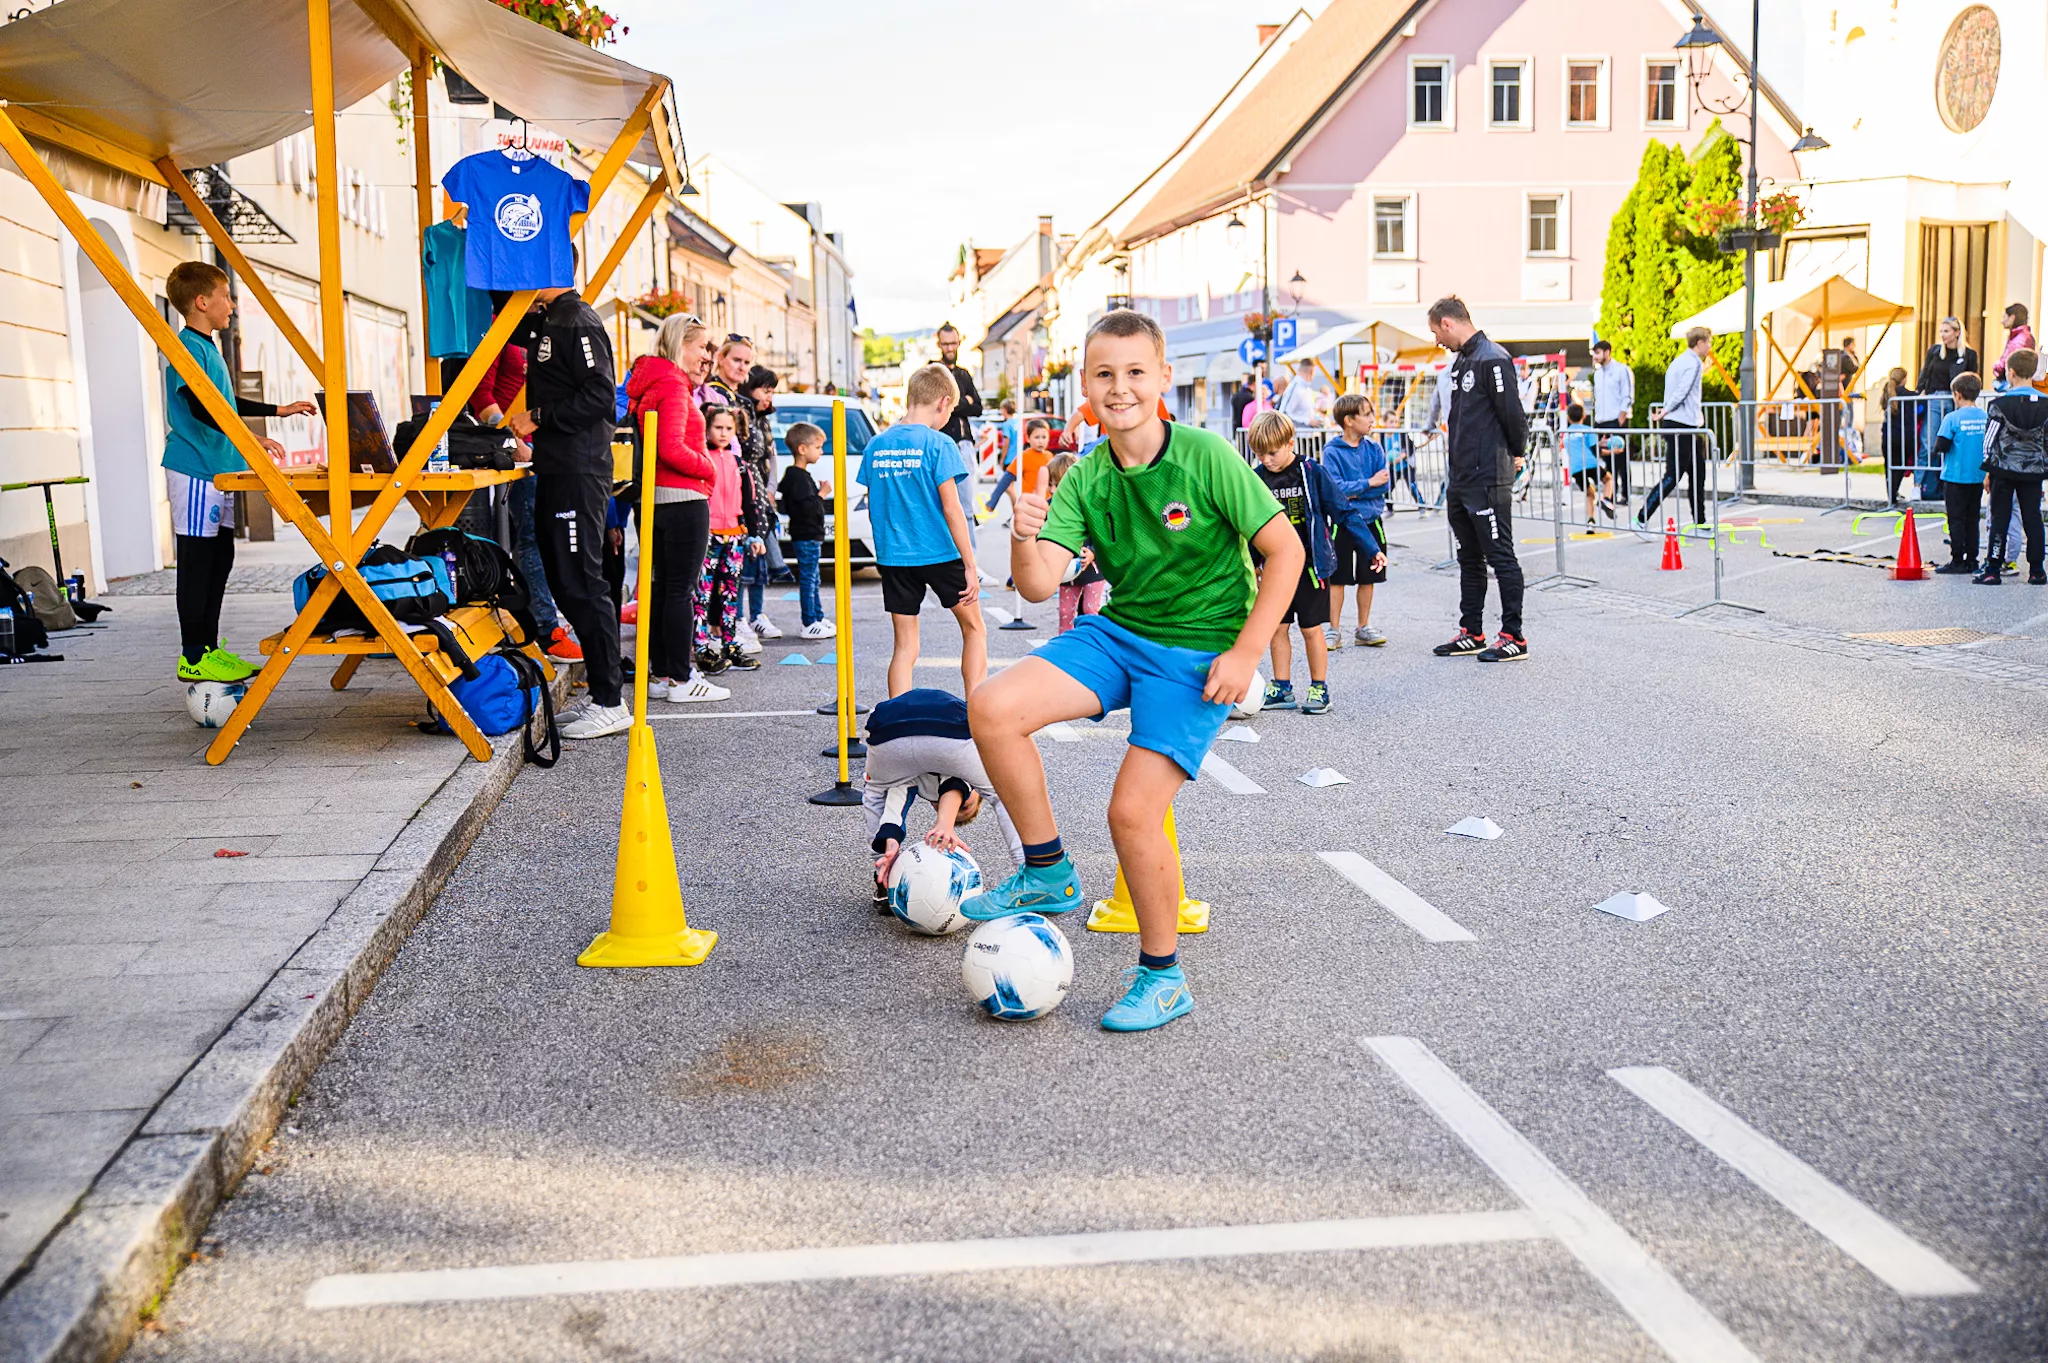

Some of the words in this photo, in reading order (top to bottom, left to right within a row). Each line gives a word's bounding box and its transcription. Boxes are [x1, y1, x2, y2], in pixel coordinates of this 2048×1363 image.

[1278, 322, 1293, 346] P
[1280, 486, 1304, 499] BREA
[179, 665, 202, 676] FILA
[973, 942, 1001, 953] capelli
